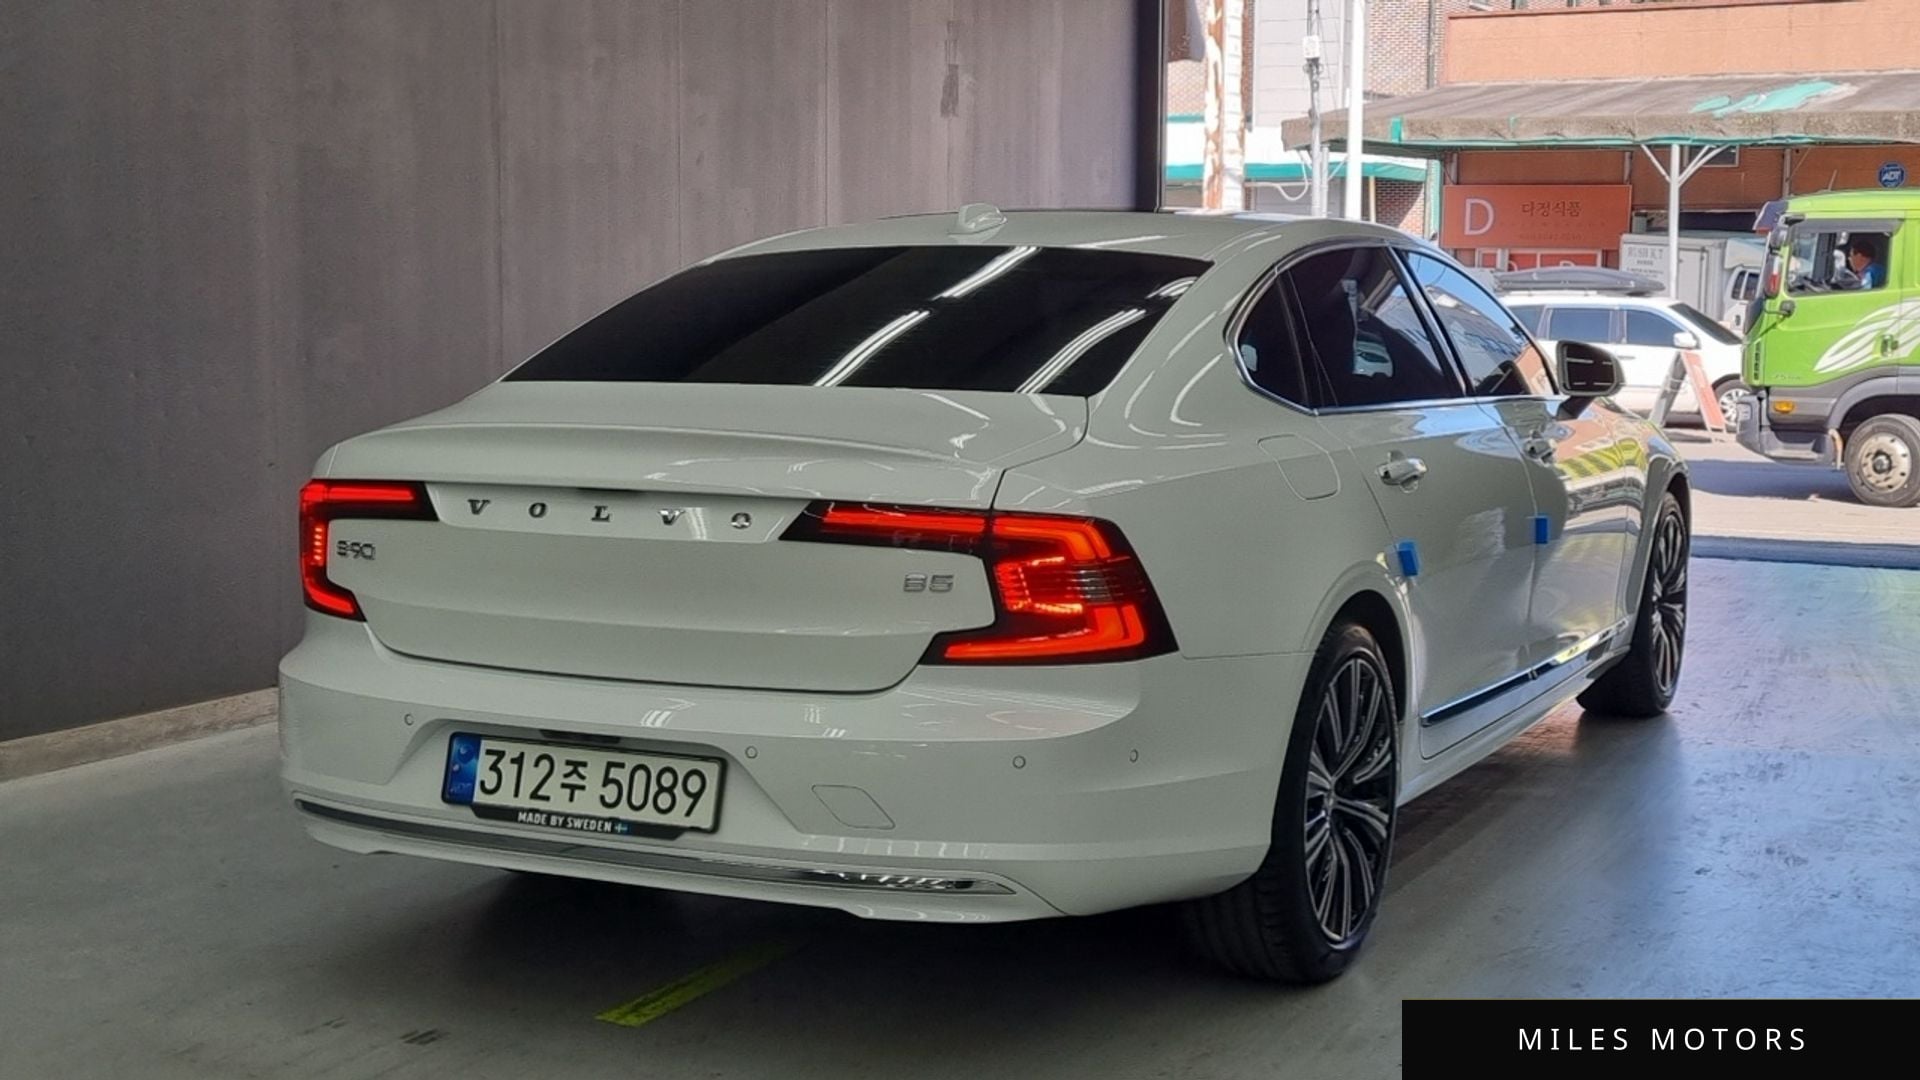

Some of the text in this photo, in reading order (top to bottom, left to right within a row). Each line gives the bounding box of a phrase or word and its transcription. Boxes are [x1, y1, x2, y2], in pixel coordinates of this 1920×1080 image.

[1882, 170, 1902, 181] ADT
[1463, 198, 1495, 236] D
[1521, 200, 1582, 217] 다정식품
[467, 498, 753, 530] VOLVO
[337, 540, 376, 561] S90
[903, 573, 954, 593] B5
[479, 748, 707, 818] 312주 5089
[518, 811, 613, 834] MADE BY SWEDEN
